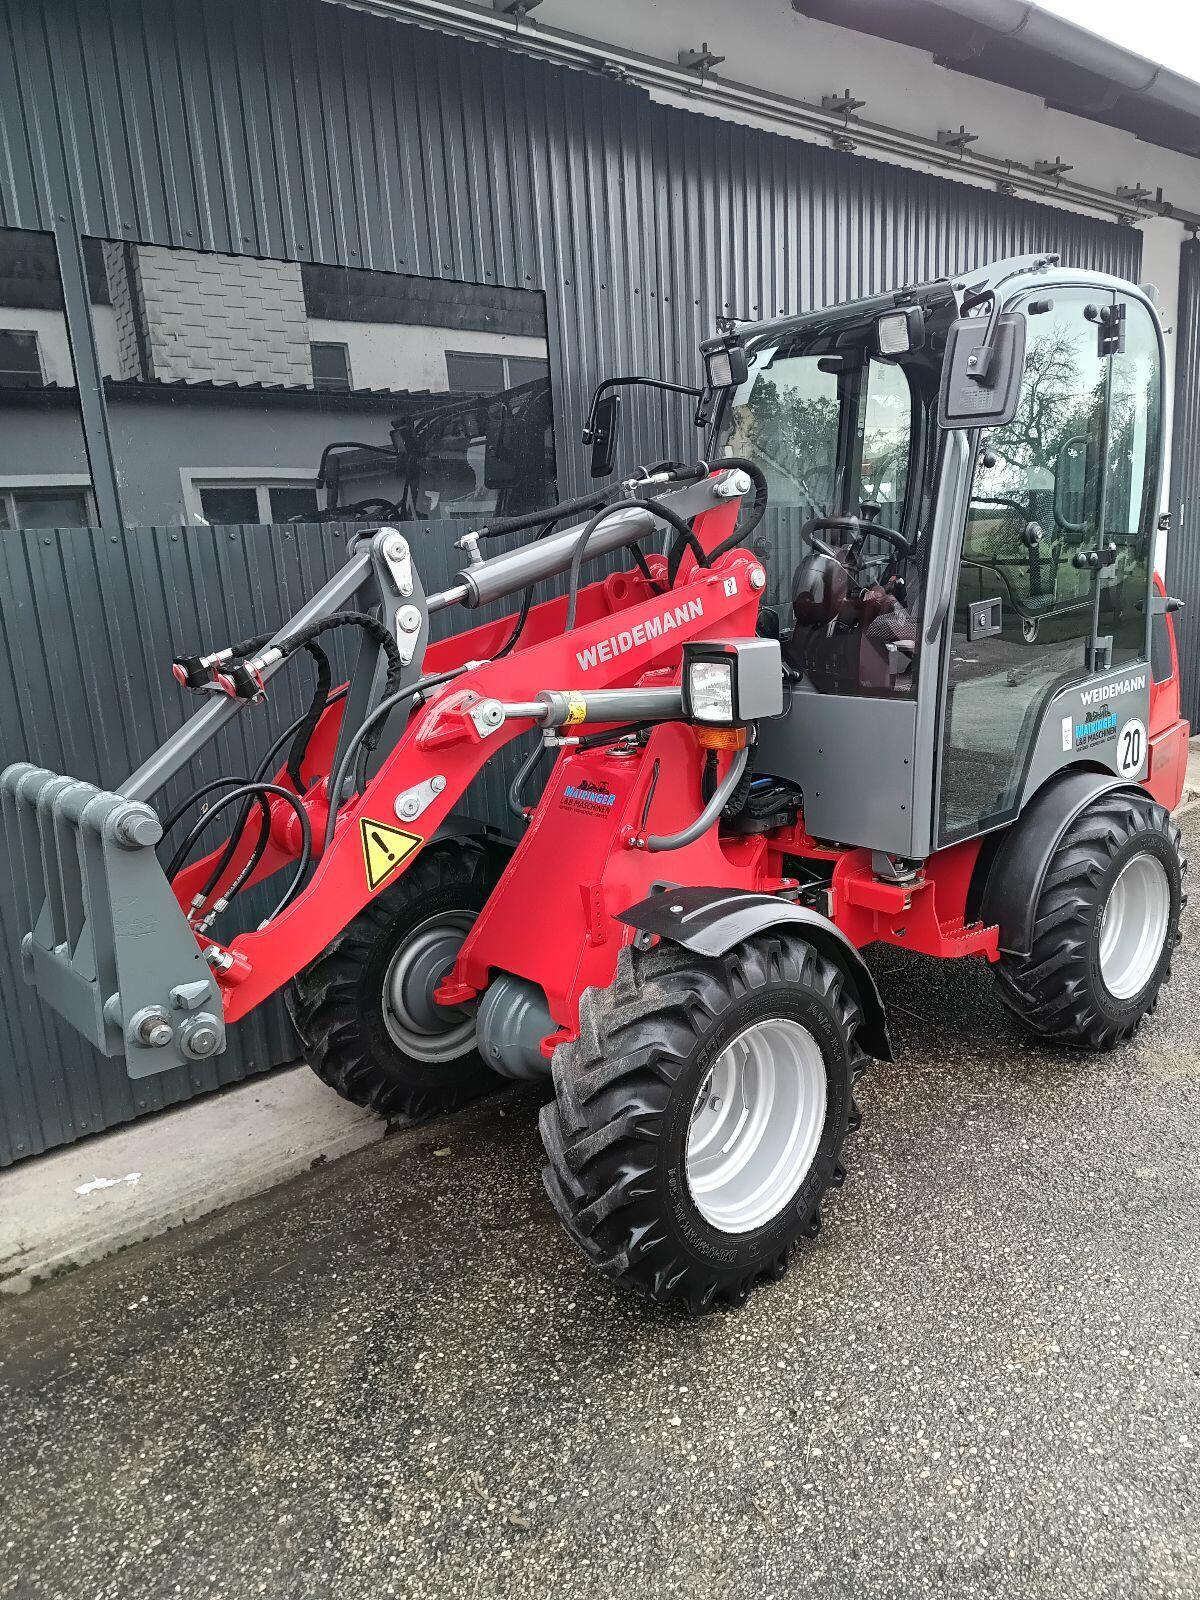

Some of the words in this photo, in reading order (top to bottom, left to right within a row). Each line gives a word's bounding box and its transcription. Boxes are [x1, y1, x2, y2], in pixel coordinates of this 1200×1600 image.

[575, 597, 704, 672] WEIDEMANN
[1080, 675, 1146, 706] WEIDEMANN
[1075, 713, 1118, 739] MAIRINGER
[1087, 726, 1117, 743] MASCHINEN
[1122, 728, 1140, 770] 20
[563, 785, 616, 806] MAIRINGER
[573, 800, 612, 815] MASCHINEN
